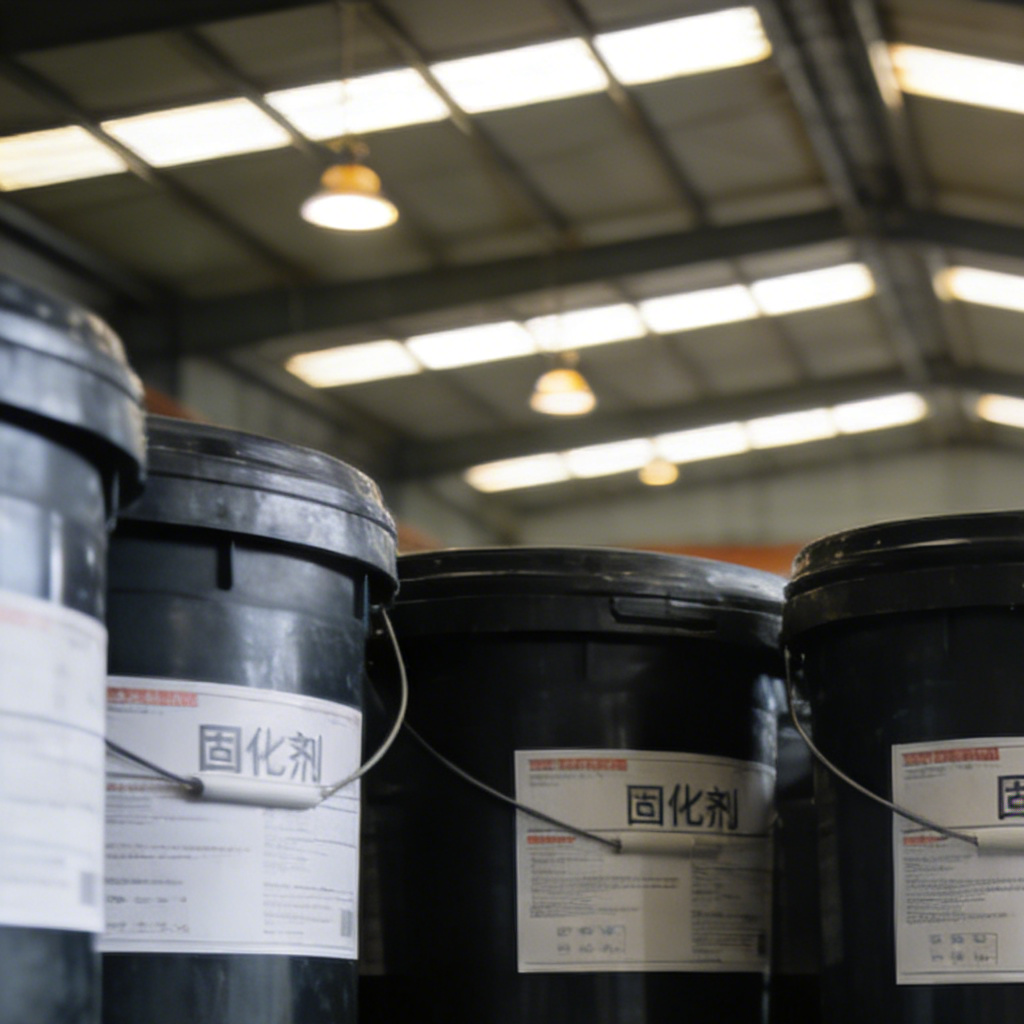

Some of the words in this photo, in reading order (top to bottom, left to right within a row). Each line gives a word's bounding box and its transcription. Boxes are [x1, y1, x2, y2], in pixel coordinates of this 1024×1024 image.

[199, 724, 322, 783] 固化剂
[626, 784, 739, 830] 固化剂
